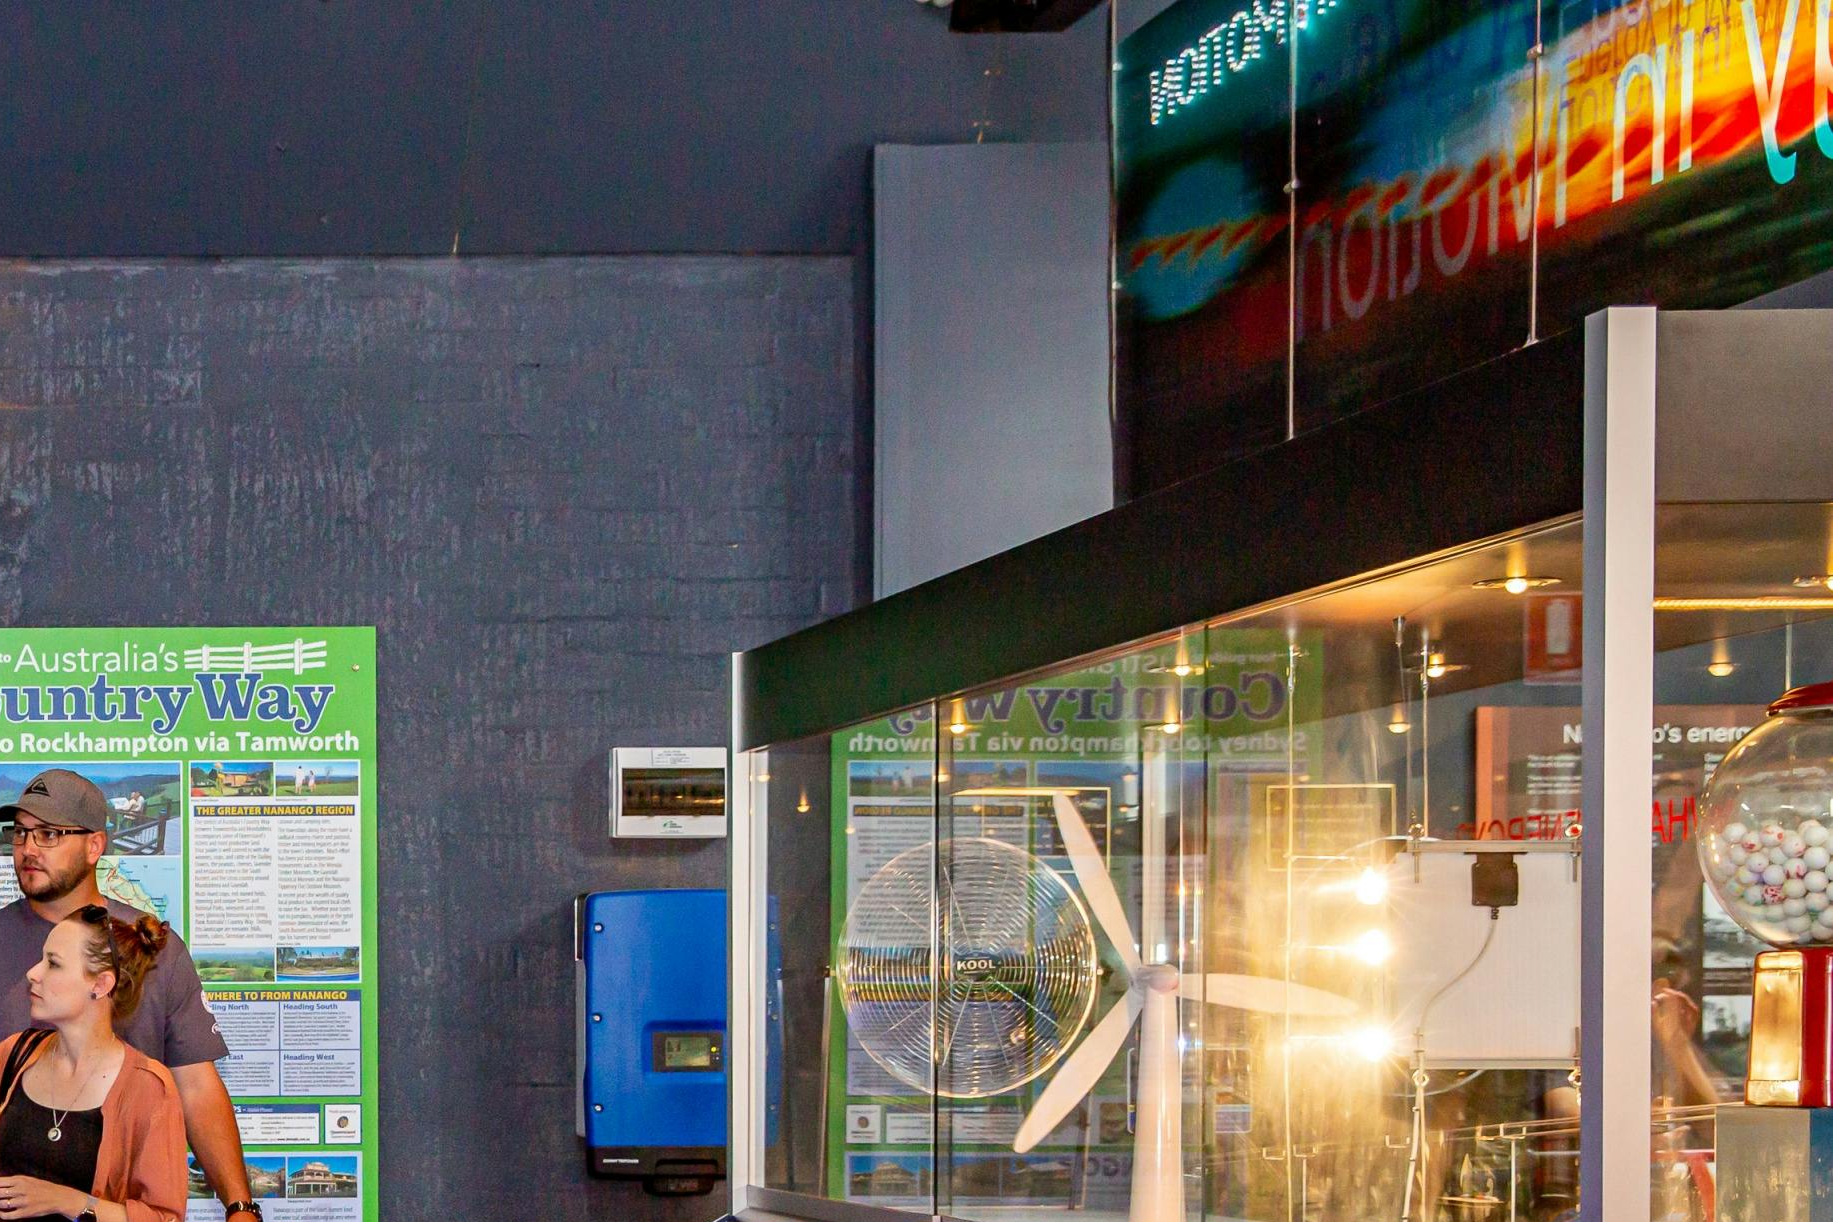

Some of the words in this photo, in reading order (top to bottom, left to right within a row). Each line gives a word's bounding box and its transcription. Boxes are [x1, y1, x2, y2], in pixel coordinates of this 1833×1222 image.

[14, 642, 178, 673] Australia's
[195, 672, 335, 734] Way
[20, 733, 188, 757] Rockhampton
[195, 733, 230, 753] via
[235, 732, 359, 752] Tamworth
[196, 806, 215, 815] THE
[217, 806, 261, 815] GREATER
[263, 806, 314, 815] NANANGO
[316, 806, 354, 815] REGION
[957, 959, 996, 970] KOOL
[205, 991, 242, 1001] WHERE
[244, 991, 258, 1000] TO
[260, 991, 290, 1000] FROM
[293, 991, 347, 1000] NANANGO
[283, 1003, 315, 1012] Heading
[283, 1053, 315, 1062] Heading
